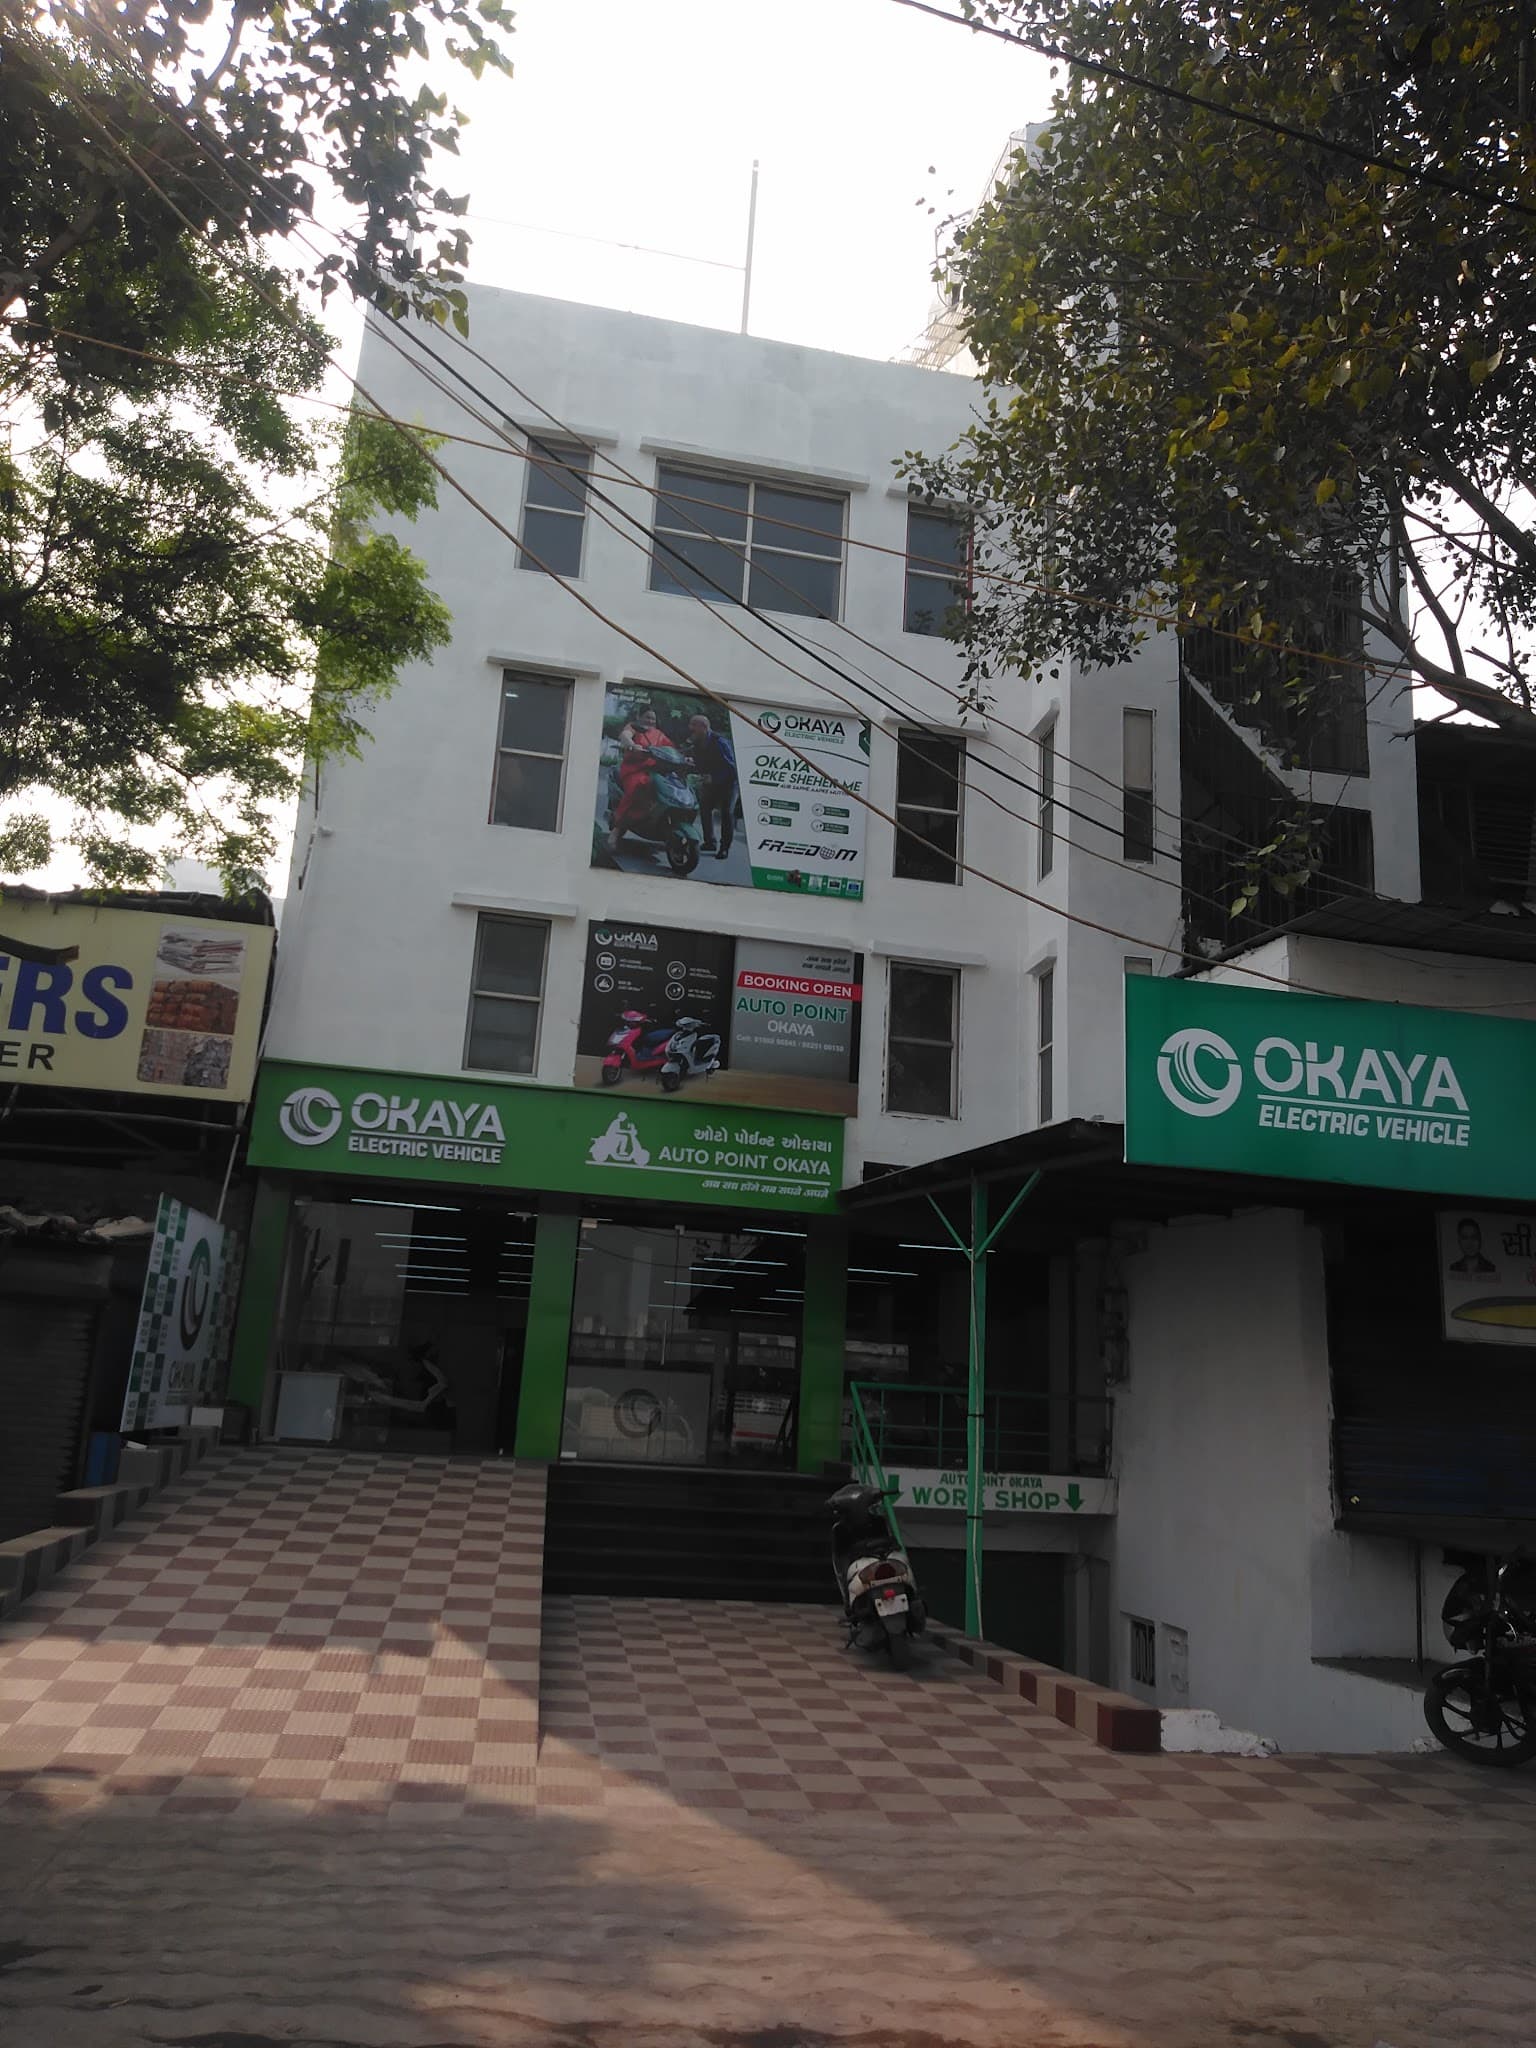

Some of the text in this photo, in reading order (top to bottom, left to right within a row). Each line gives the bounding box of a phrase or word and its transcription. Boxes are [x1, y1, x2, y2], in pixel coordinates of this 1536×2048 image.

[785, 714, 846, 736] OKAYA
[750, 769, 787, 782] APKE
[755, 755, 810, 773] OKAYA
[614, 930, 658, 945] OKAYA
[744, 975, 852, 998] BOOKING OPEN
[736, 996, 848, 1023] AUTO POINT
[767, 1019, 815, 1037] OKAYA
[1253, 1036, 1470, 1112] OKAYA
[351, 1092, 506, 1141] OKAYA
[1258, 1103, 1470, 1147] ELECTRIC VEHICLE
[349, 1135, 501, 1164] ELECTRIC VEHICLE
[658, 1146, 832, 1176] AUTO POINT OKAYA
[1009, 1476, 1043, 1489] OKAYA
[912, 1485, 1060, 1511] WOR SHOP
